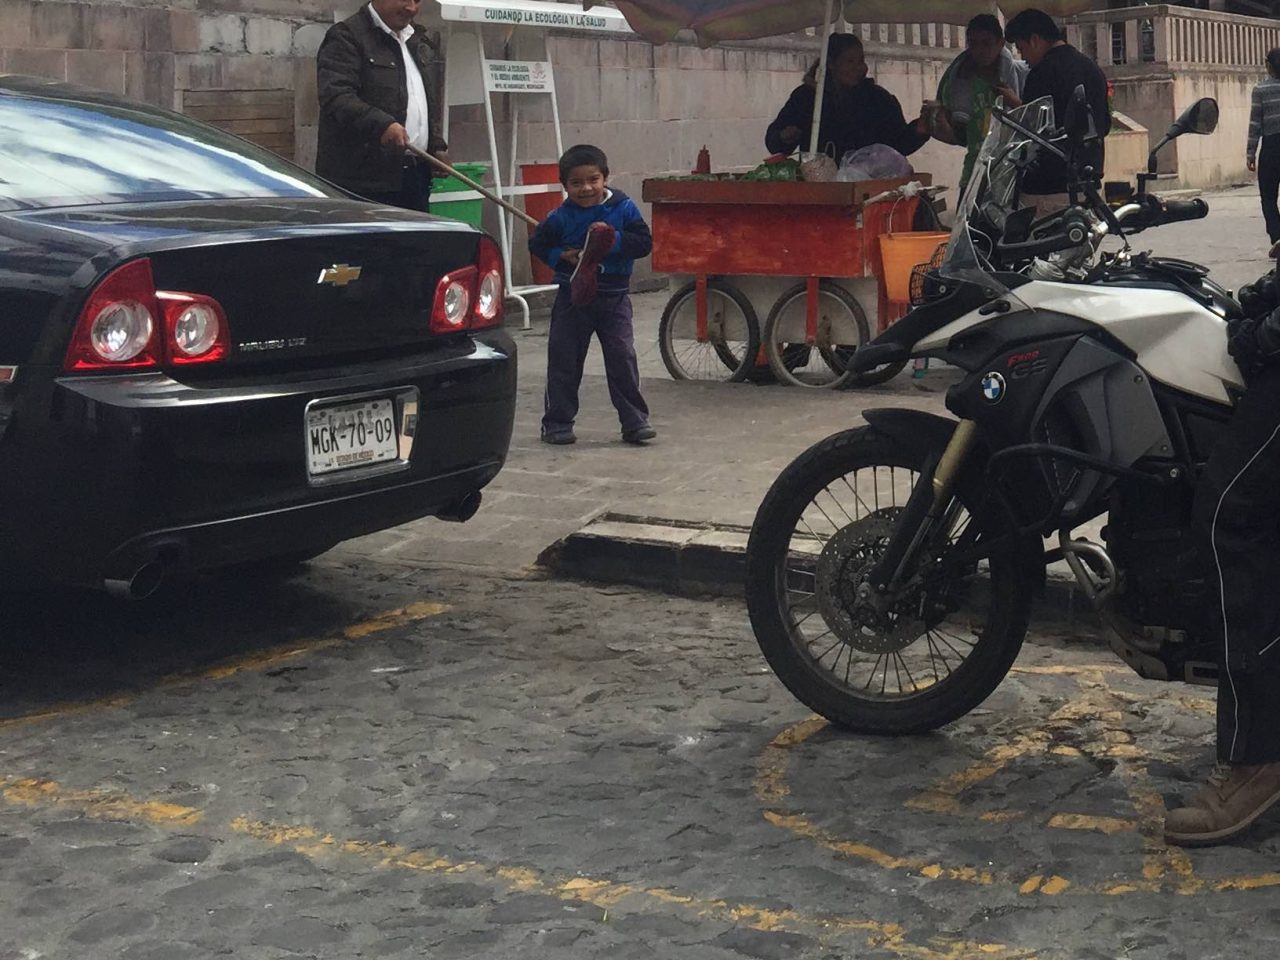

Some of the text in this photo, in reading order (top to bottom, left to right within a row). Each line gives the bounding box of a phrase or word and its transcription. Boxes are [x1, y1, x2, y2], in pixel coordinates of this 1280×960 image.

[484, 8, 522, 22] CUIDANDO
[524, 12, 533, 22] LA
[535, 13, 569, 25] ECOLOGIA
[568, 16, 575, 25] Y
[585, 16, 606, 27] SALUD
[310, 417, 392, 455] MGK-70-09
